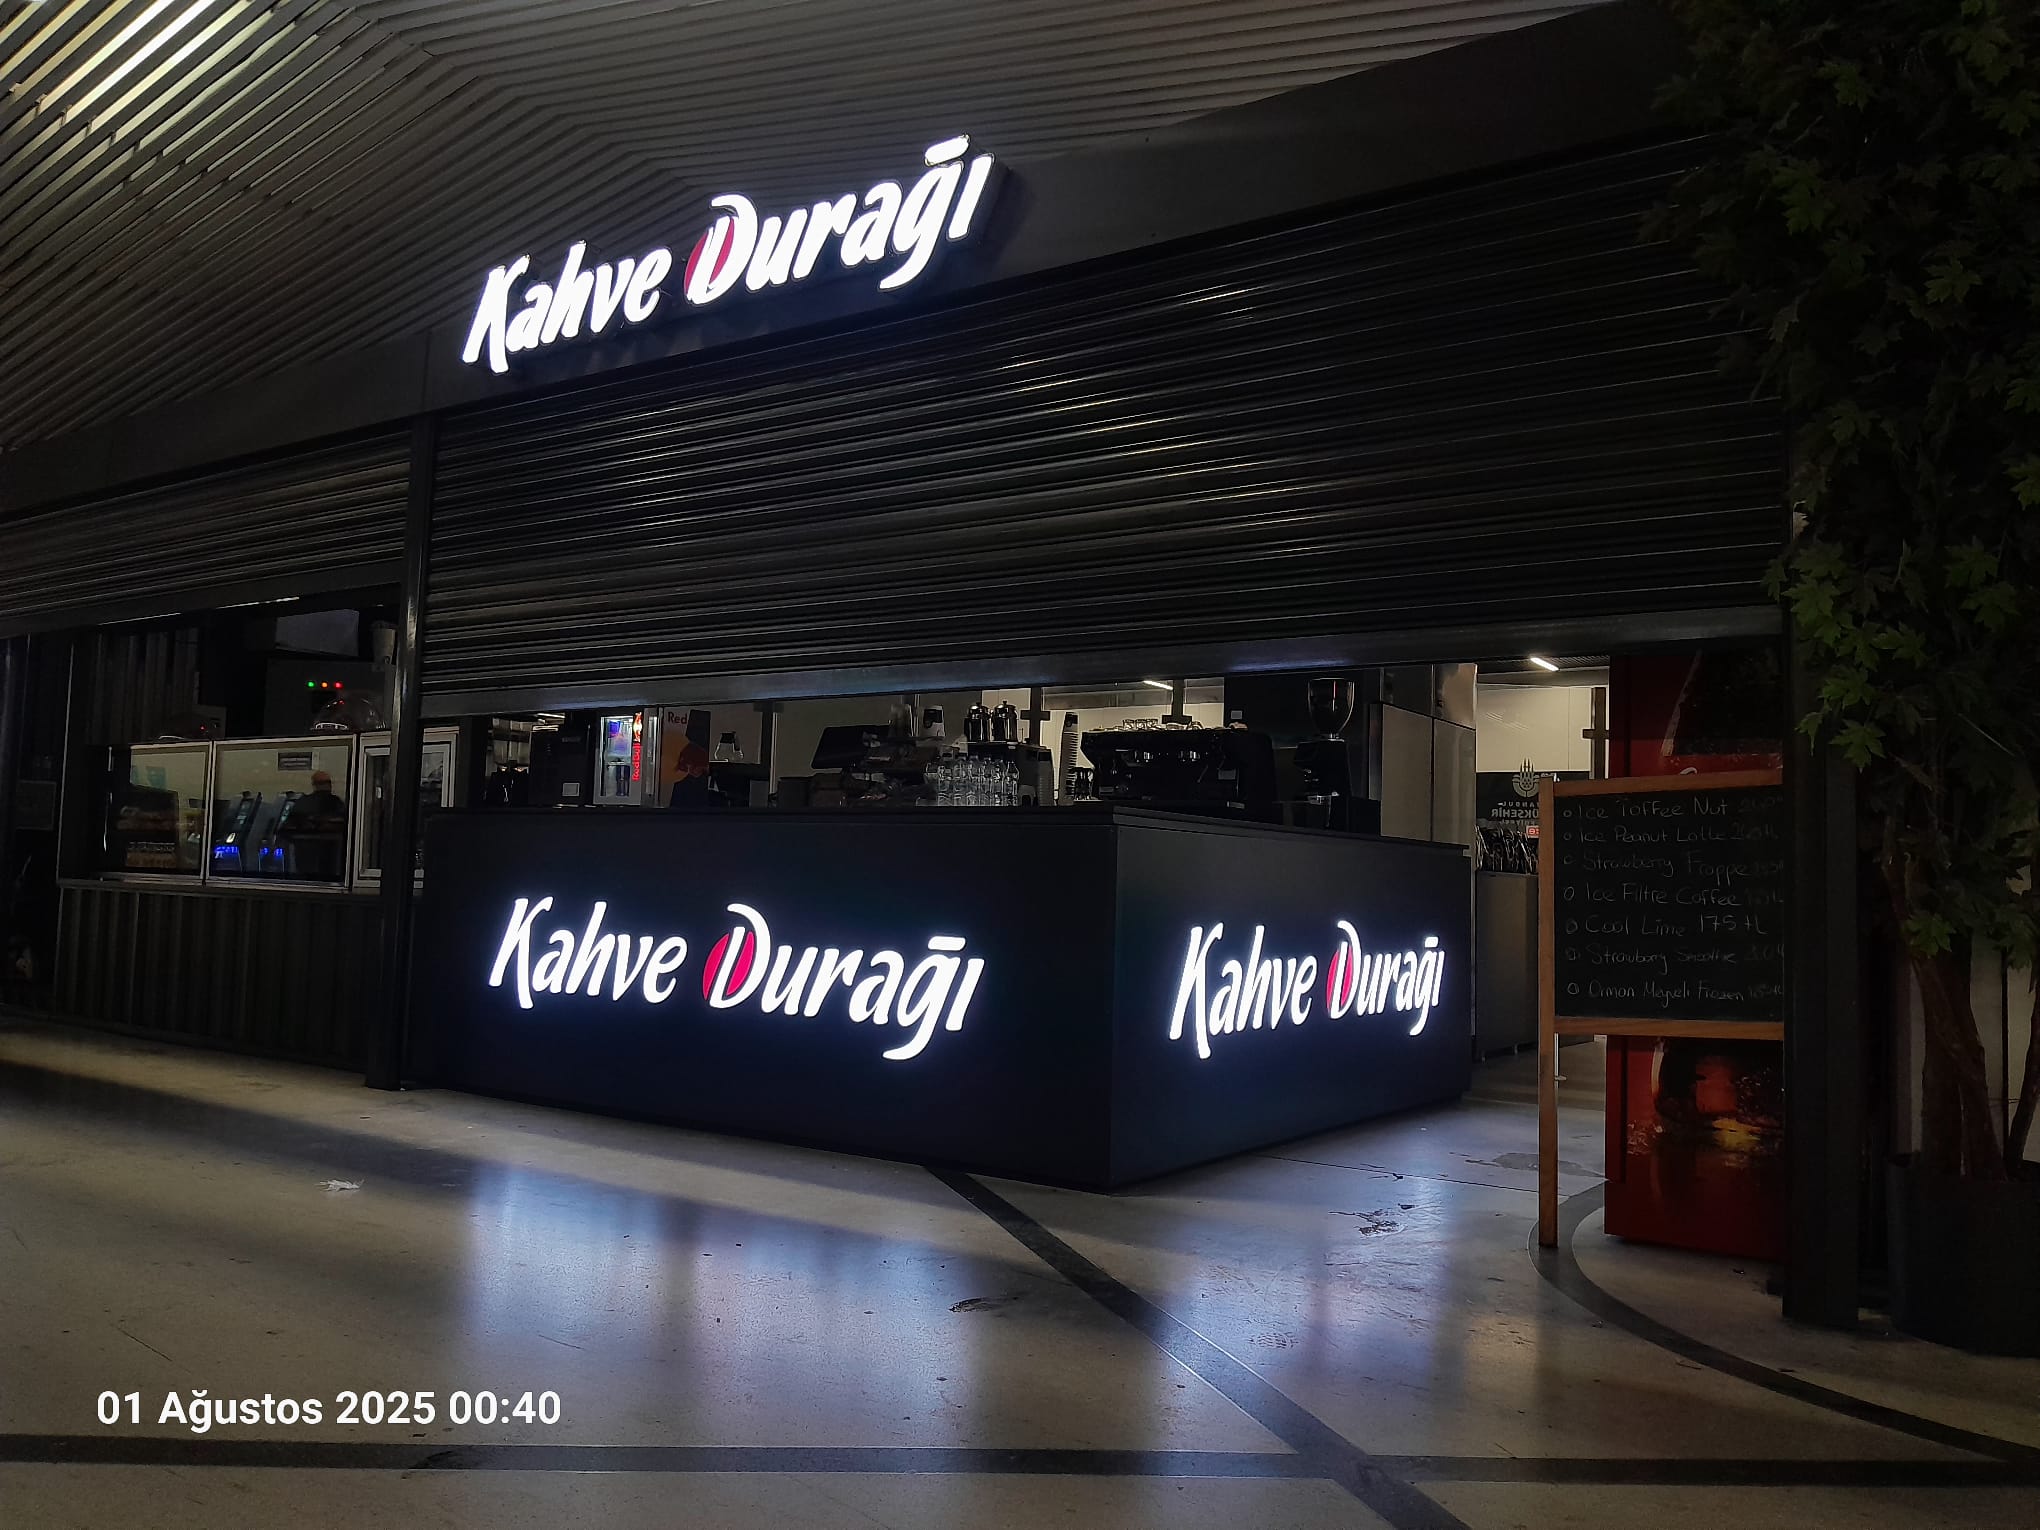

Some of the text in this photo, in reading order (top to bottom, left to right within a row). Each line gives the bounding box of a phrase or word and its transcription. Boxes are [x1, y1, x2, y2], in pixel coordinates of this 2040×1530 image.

[461, 134, 992, 375] Kahve Durağı
[1579, 803, 1608, 819] Ice
[1694, 796, 1729, 817] Nut
[1579, 829, 1607, 844] Ice
[1614, 825, 1669, 843] Peanut
[1587, 883, 1616, 903] Ice
[1622, 882, 1669, 904] Filtre
[1676, 887, 1743, 906] Coffee
[1585, 914, 1630, 936] Cool
[1642, 915, 1687, 936] Lime
[1700, 913, 1737, 934] 175
[487, 896, 985, 1061] Kahve Durağı
[1168, 920, 1445, 1060] Kahve Durağı
